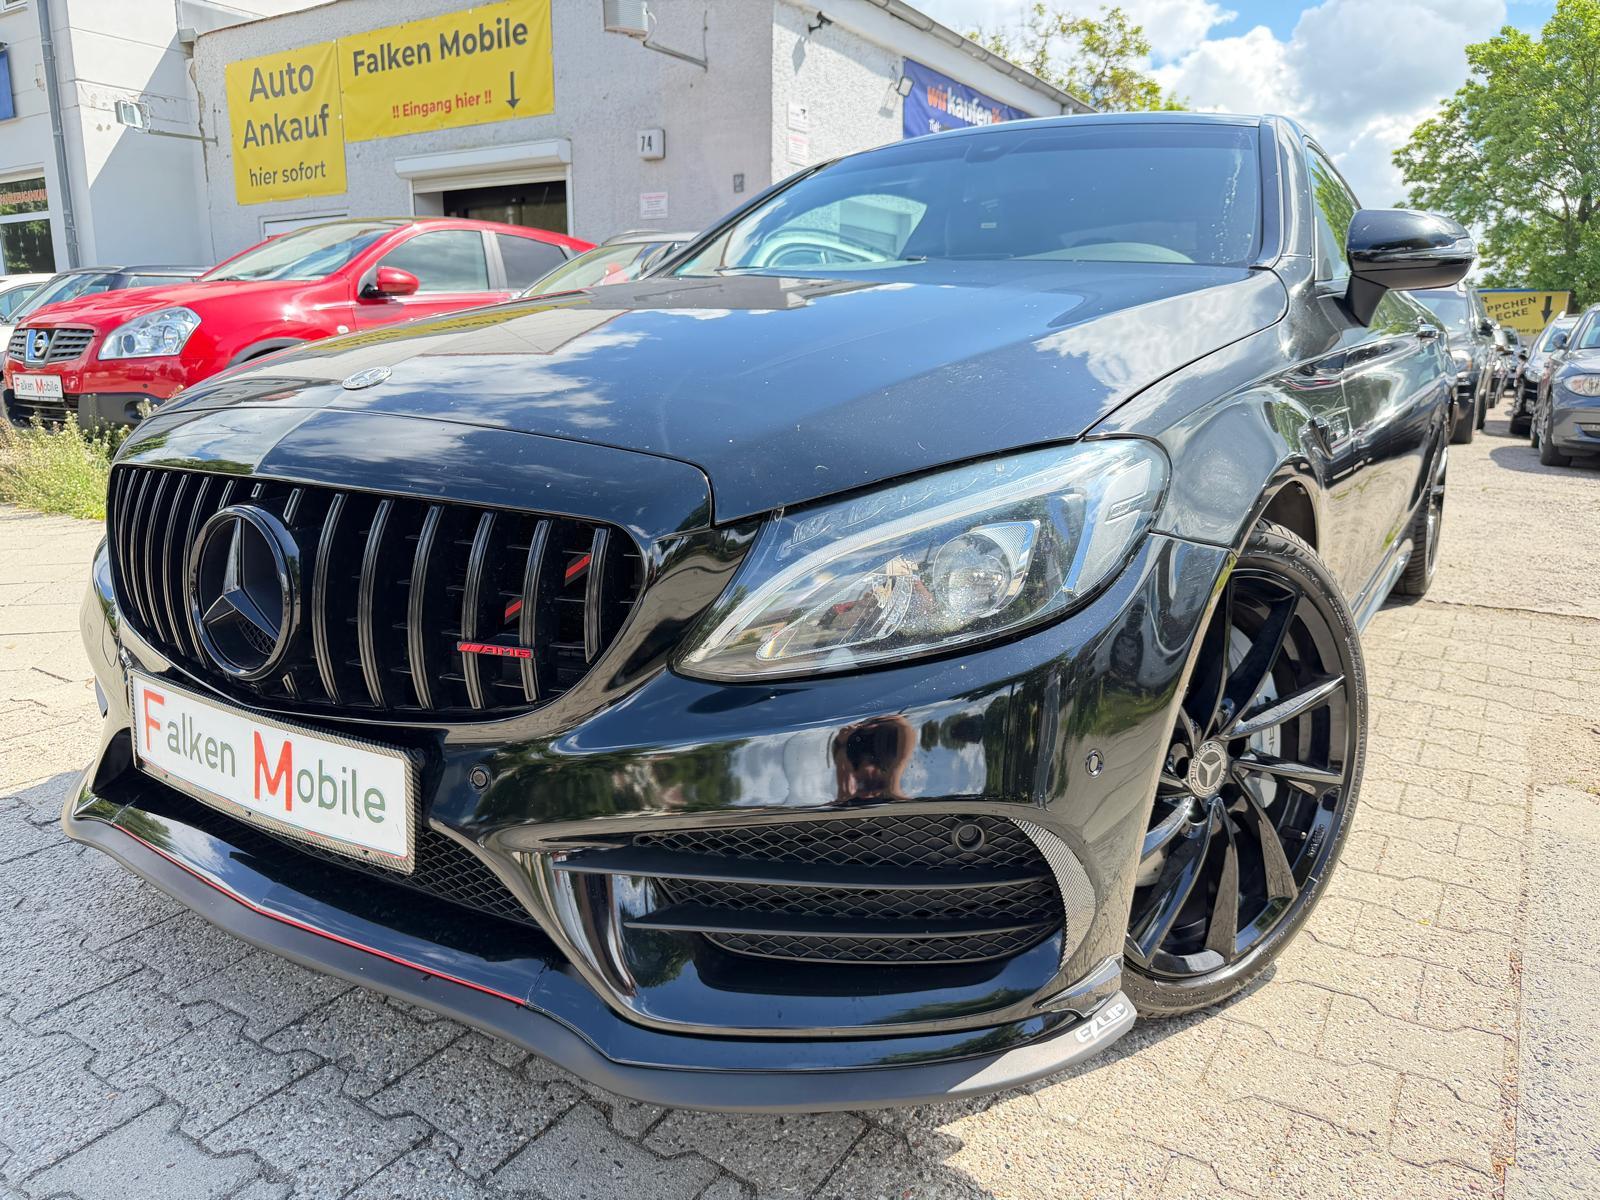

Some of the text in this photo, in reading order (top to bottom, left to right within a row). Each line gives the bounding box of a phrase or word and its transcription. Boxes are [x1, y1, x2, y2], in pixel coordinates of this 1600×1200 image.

[353, 17, 528, 77] Falken Mobile
[249, 62, 314, 103] Auto
[403, 98, 452, 118] Eingang
[455, 91, 481, 110] hier
[243, 103, 329, 149] Ankauf
[640, 135, 653, 152] 74
[249, 160, 326, 187] hier sofort
[1487, 297, 1536, 313] PPCHEN
[481, 645, 531, 658] AMG
[142, 687, 386, 824] Falken Mobile
